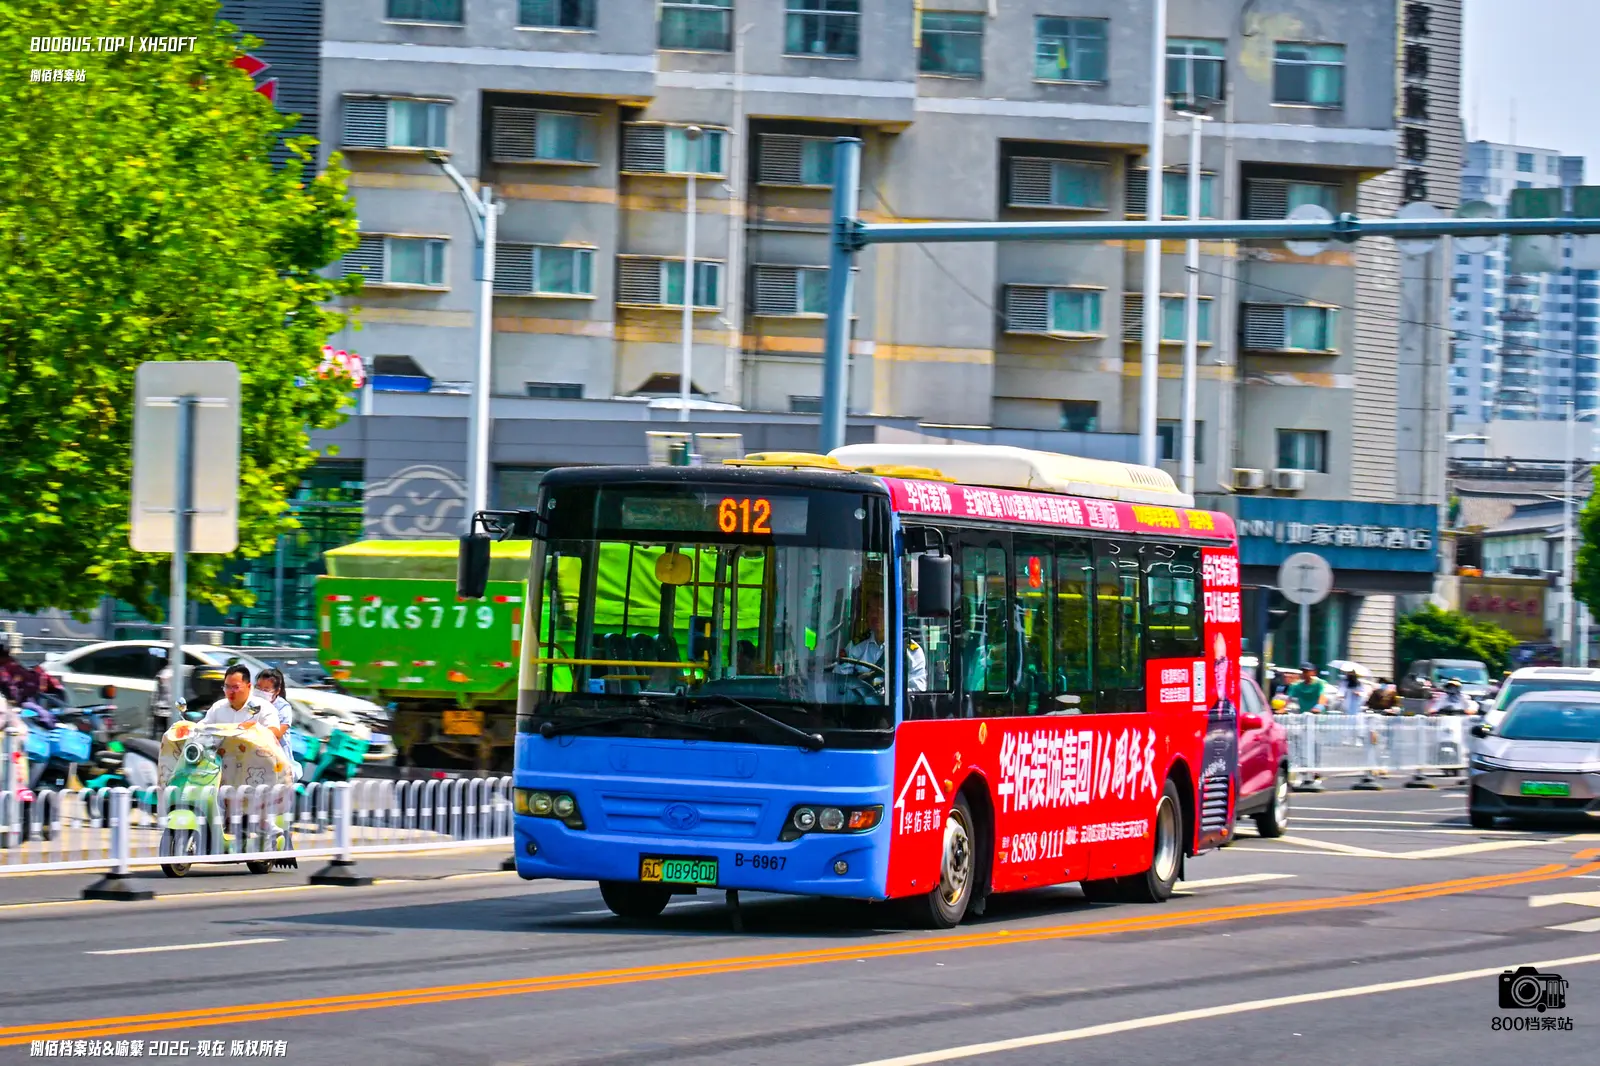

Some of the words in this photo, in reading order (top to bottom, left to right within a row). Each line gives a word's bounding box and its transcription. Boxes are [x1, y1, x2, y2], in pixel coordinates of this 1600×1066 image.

[904, 481, 952, 513] 华佑装饰
[718, 497, 772, 534] 612
[1203, 554, 1239, 588] 华佑装饰
[904, 808, 941, 835] 华佑装饰
[735, 852, 787, 871] B-6967
[1011, 831, 1038, 863] 8588
[1039, 829, 1064, 860] 9111
